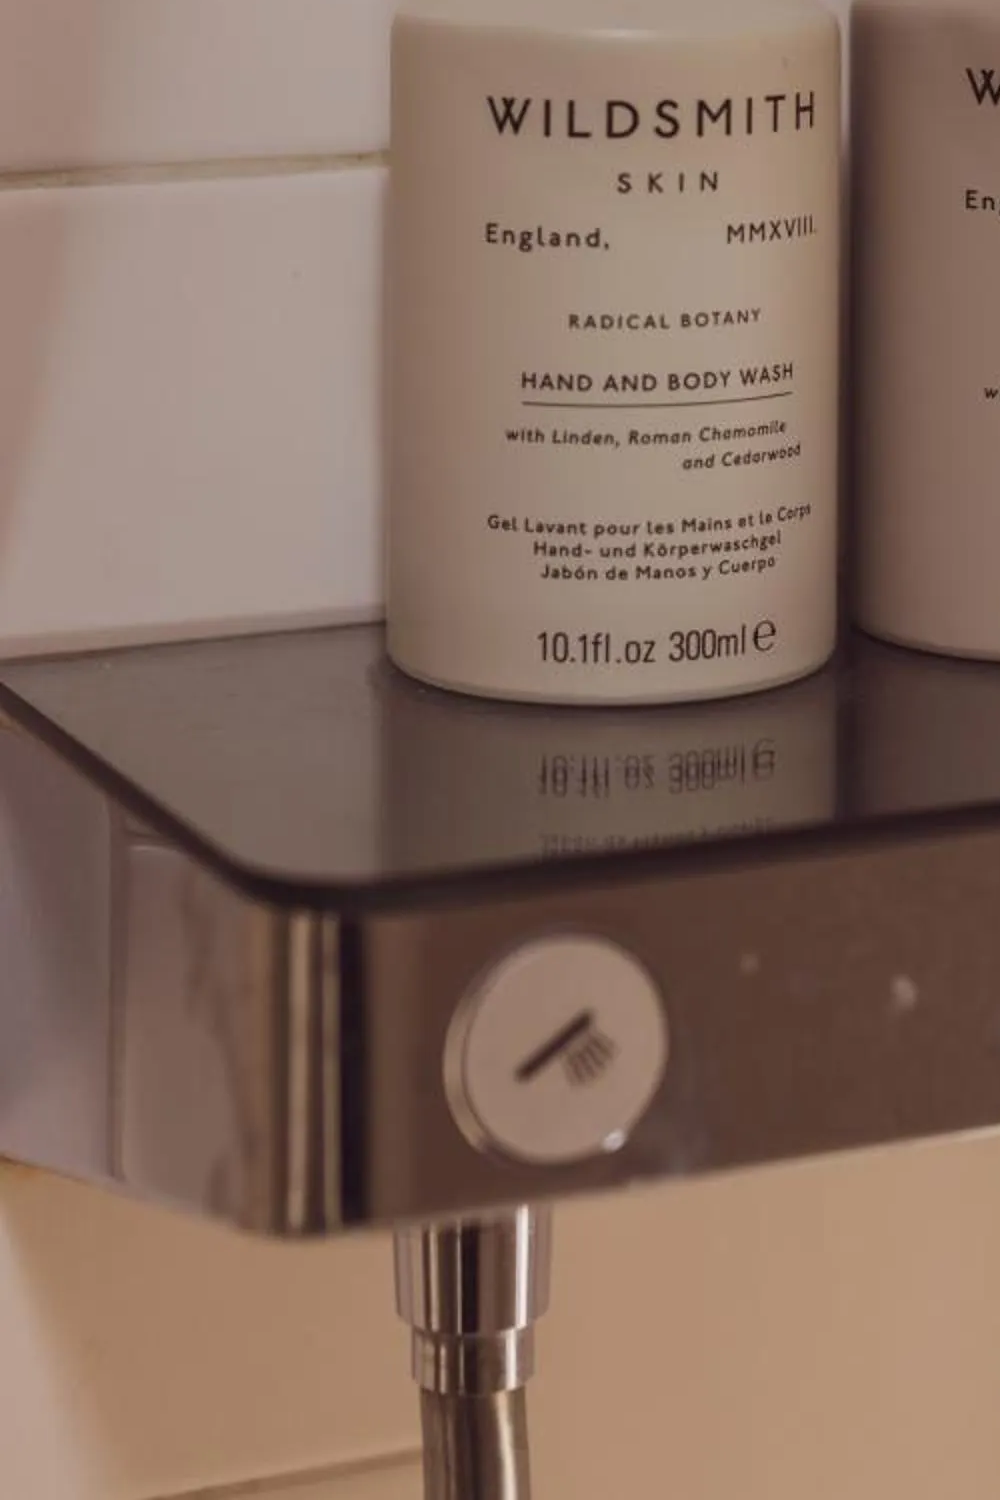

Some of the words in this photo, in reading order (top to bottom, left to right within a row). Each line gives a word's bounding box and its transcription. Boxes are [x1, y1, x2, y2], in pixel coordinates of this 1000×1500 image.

[485, 91, 815, 140] WILDSMITH
[616, 170, 719, 195] SKIN
[484, 221, 610, 253] England,
[567, 313, 671, 331] RADICAL
[679, 307, 761, 329] BOTANY
[520, 371, 594, 393] HAND
[602, 372, 659, 393] AND
[667, 369, 732, 392] BODY
[738, 362, 794, 387] WASH
[505, 427, 546, 444] with
[551, 428, 621, 448] Linden,
[627, 428, 693, 446] Roman
[698, 419, 790, 445] Chamomile
[681, 455, 716, 471] and
[720, 444, 801, 468] Cedarwood
[486, 513, 519, 533] Gel
[523, 517, 588, 537] Lavant
[592, 523, 641, 539] pour
[645, 520, 676, 537] les
[680, 516, 733, 534] Mains
[737, 513, 755, 529] et
[758, 509, 774, 526] le
[532, 538, 593, 559] Hand-
[598, 539, 637, 559] und
[642, 530, 782, 561] Körperwaschgel
[539, 563, 599, 581] Jabón
[604, 565, 629, 581] de
[634, 564, 698, 581] Manos
[701, 565, 713, 580] y
[717, 554, 776, 576] Cuerpo
[536, 631, 657, 665] 10.1fl.oz
[668, 623, 747, 663] 300ml
